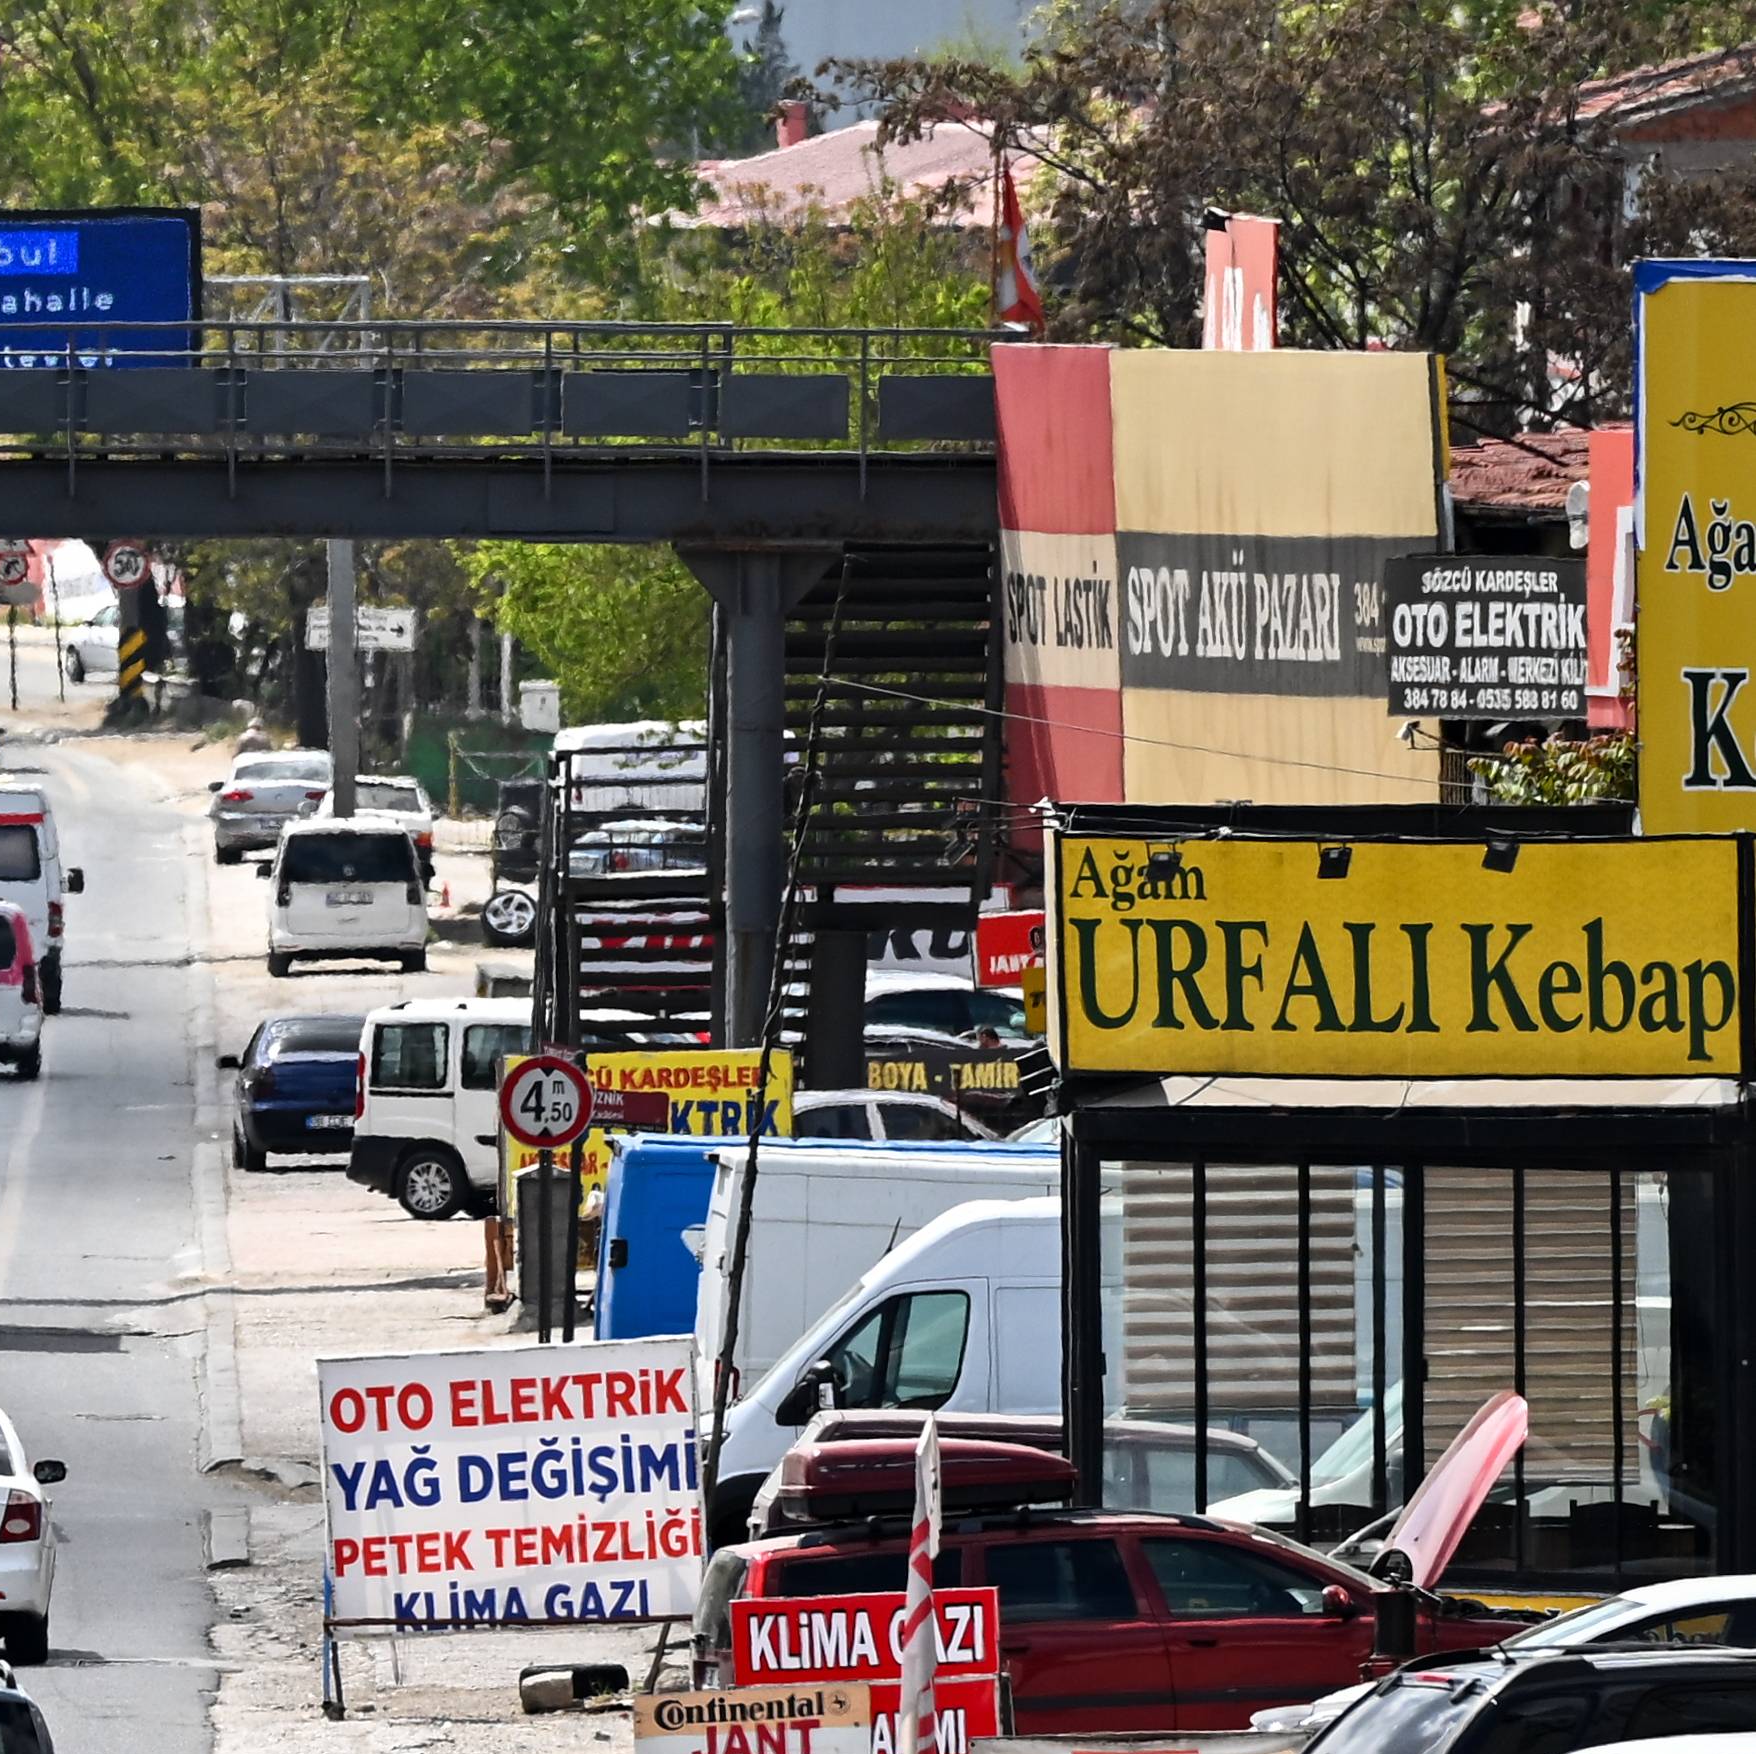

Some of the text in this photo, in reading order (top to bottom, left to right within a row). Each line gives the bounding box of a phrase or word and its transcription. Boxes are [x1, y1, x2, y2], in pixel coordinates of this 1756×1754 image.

[1007, 560, 1113, 650] SPOT LASTİK
[1128, 550, 1342, 662] SPOT AKÜ PAZARI
[1421, 567, 1559, 598] SÖZCÜ KARDEŞLER
[1392, 593, 1587, 650] OTO ELEKTRİK
[1391, 655, 1452, 683] AKSESUAR
[1458, 656, 1500, 684] ALARM
[1403, 687, 1429, 710] 384
[1430, 688, 1448, 710] 78
[1450, 688, 1468, 710] 84
[1560, 689, 1579, 711] 60
[1069, 846, 1208, 910] Ağam
[1068, 916, 1738, 1061] URFALI Kebap
[868, 1062, 928, 1091] BOYA
[949, 1057, 1021, 1090] TAMİR
[329, 1367, 689, 1434] OTO ELEKTRİK
[330, 1428, 699, 1512] YAĞ DEĞİŞİMİ
[333, 1506, 702, 1578] PETEK TEMİZLİĞİ
[393, 1578, 651, 1633] KLİMA GAZI
[748, 1610, 881, 1673] KLİMA
[653, 1690, 826, 1731] Continental
